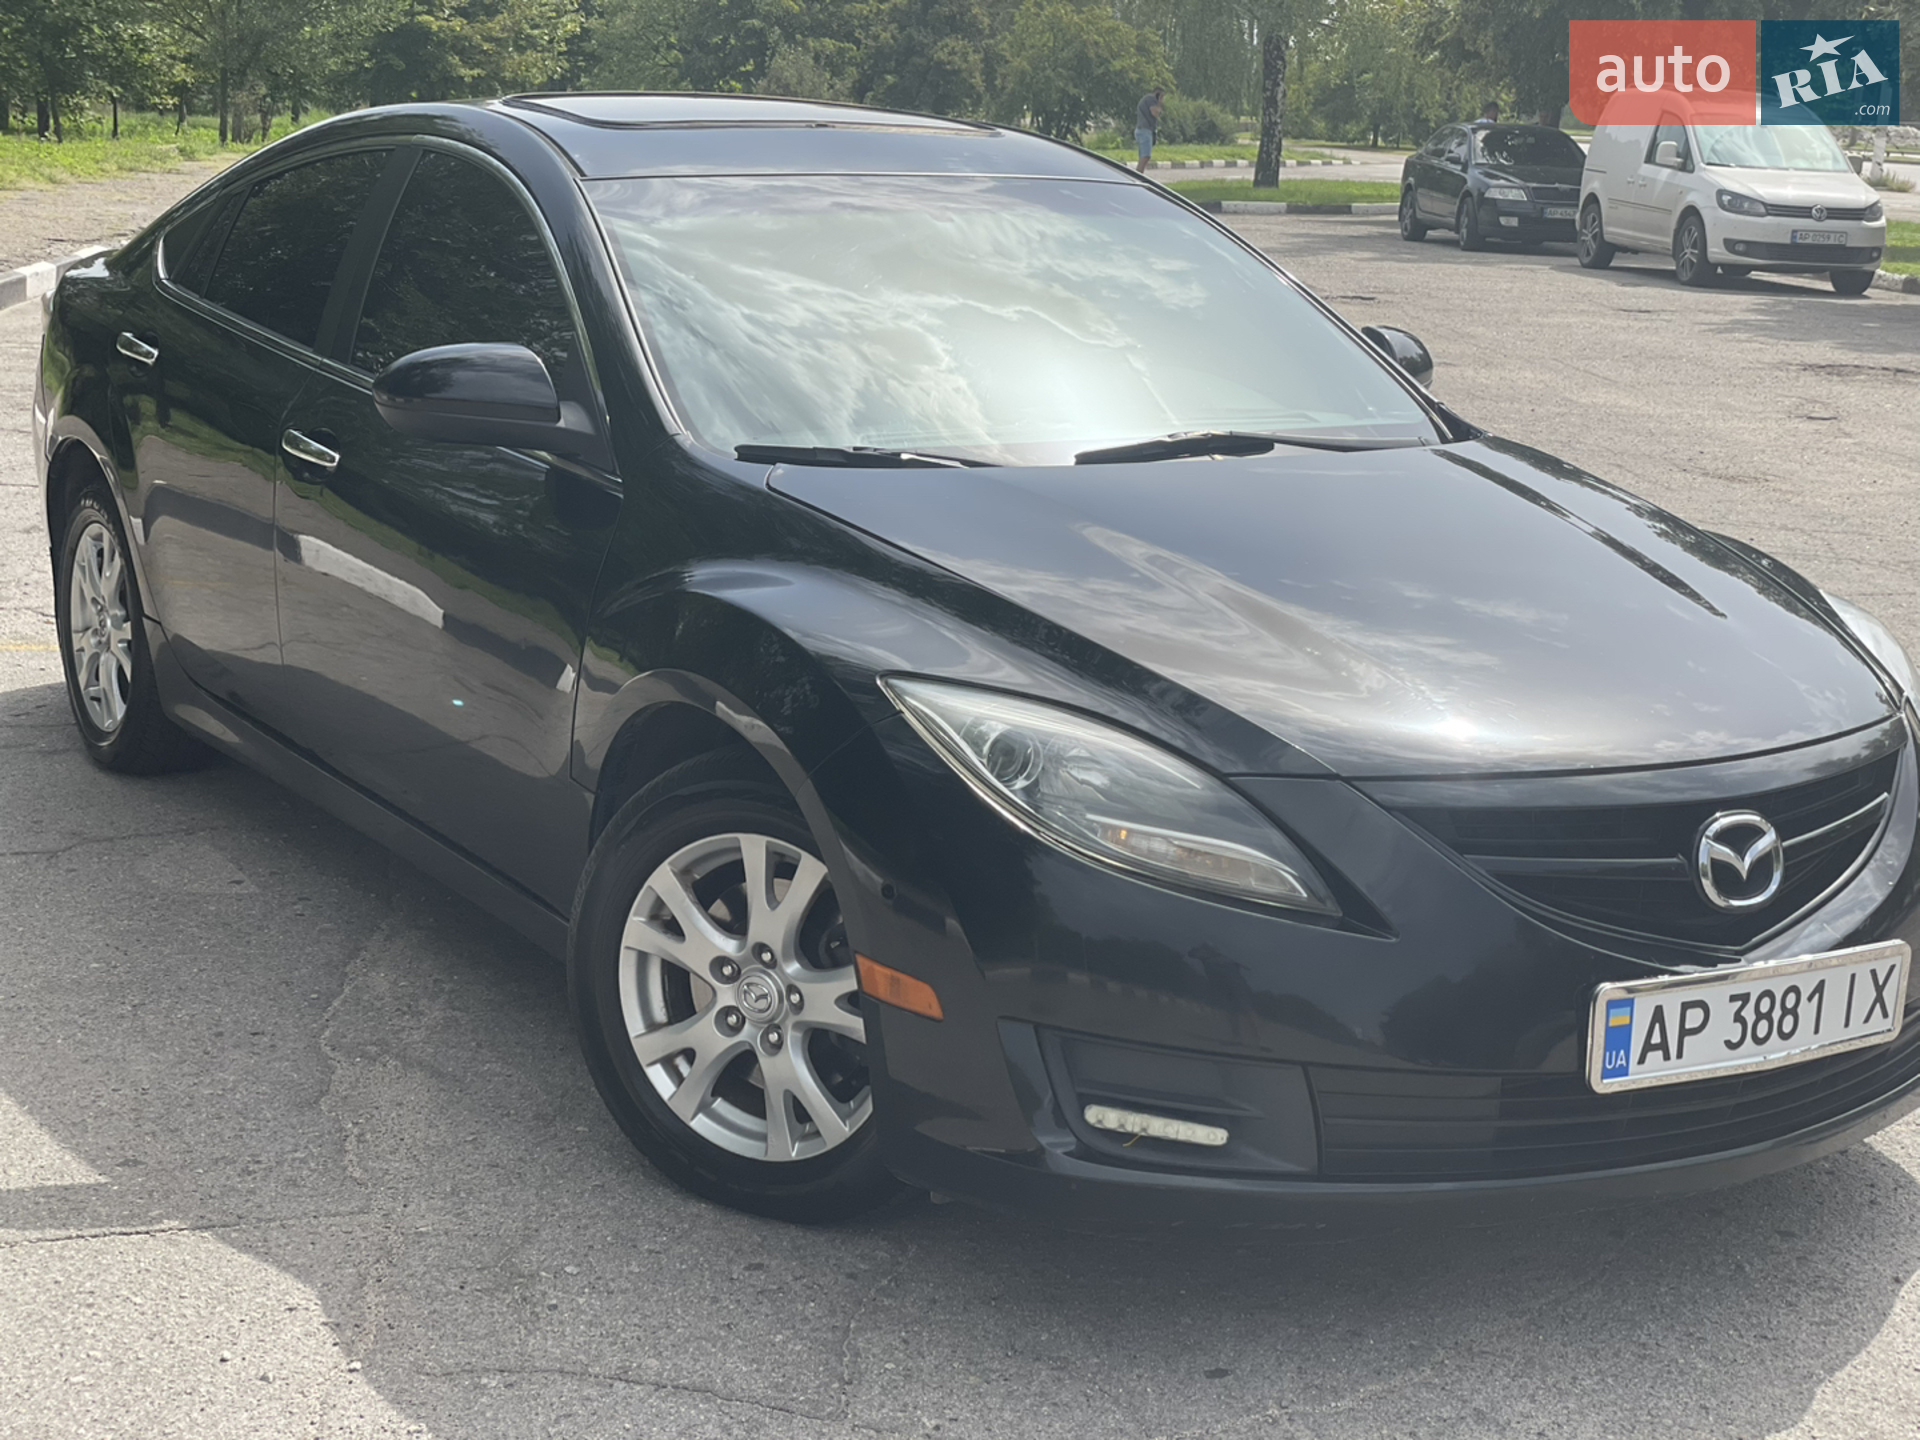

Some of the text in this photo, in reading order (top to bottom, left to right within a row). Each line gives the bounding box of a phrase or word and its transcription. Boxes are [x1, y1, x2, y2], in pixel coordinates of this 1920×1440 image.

[1799, 232, 1810, 241] AP
[1636, 963, 1897, 1066] AP 3881 IX
[1605, 1049, 1627, 1069] UA
